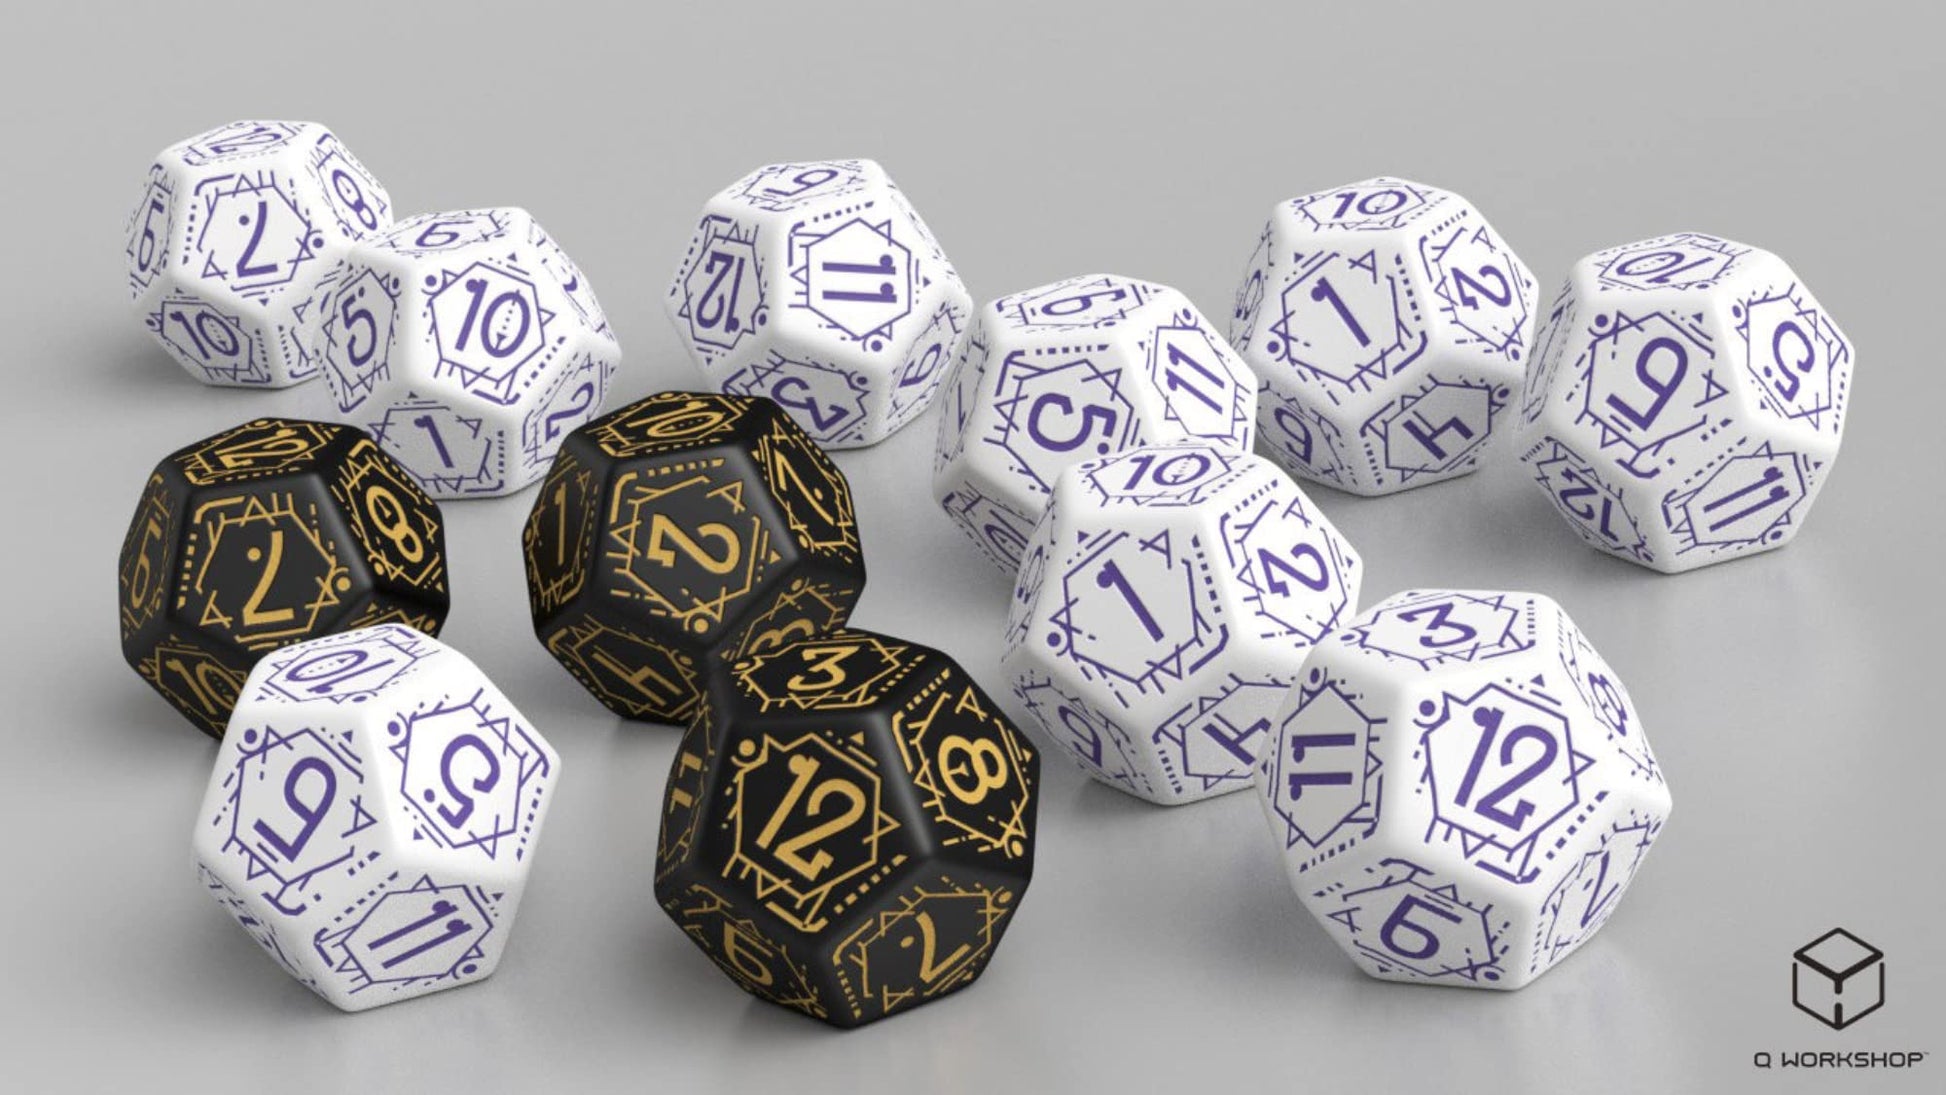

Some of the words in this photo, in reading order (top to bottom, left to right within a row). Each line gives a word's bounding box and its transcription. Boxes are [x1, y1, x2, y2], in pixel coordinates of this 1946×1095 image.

[331, 168, 377, 231] 8
[1331, 189, 1408, 218] 10
[235, 200, 279, 278] 7
[694, 251, 746, 334] 12
[820, 254, 898, 305] 11
[1309, 277, 1372, 348] 1
[1453, 262, 1512, 310] 2
[170, 310, 239, 360] 10
[341, 288, 379, 368] 5
[454, 277, 531, 358] 10
[1166, 344, 1225, 416] 11
[1763, 319, 1818, 402] 5
[413, 414, 453, 468] 1
[545, 380, 594, 443] 2
[1027, 393, 1117, 454] 5
[1123, 450, 1214, 489] 10
[1703, 466, 1791, 531] 11
[366, 485, 425, 563] 8
[555, 482, 568, 566] 1
[645, 511, 742, 575] 2
[242, 529, 294, 625] 7
[1095, 557, 1166, 645] 1
[1256, 540, 1333, 600] 2
[1399, 600, 1480, 648] 3
[165, 655, 243, 715] 10
[282, 647, 395, 695] 10
[789, 643, 861, 692] 3
[422, 732, 503, 830] 5
[936, 734, 1009, 806] 8
[1287, 731, 1358, 801] 11
[1454, 705, 1560, 830] 12
[754, 753, 867, 883] 12
[367, 900, 472, 970] 11
[898, 909, 972, 984] 7
